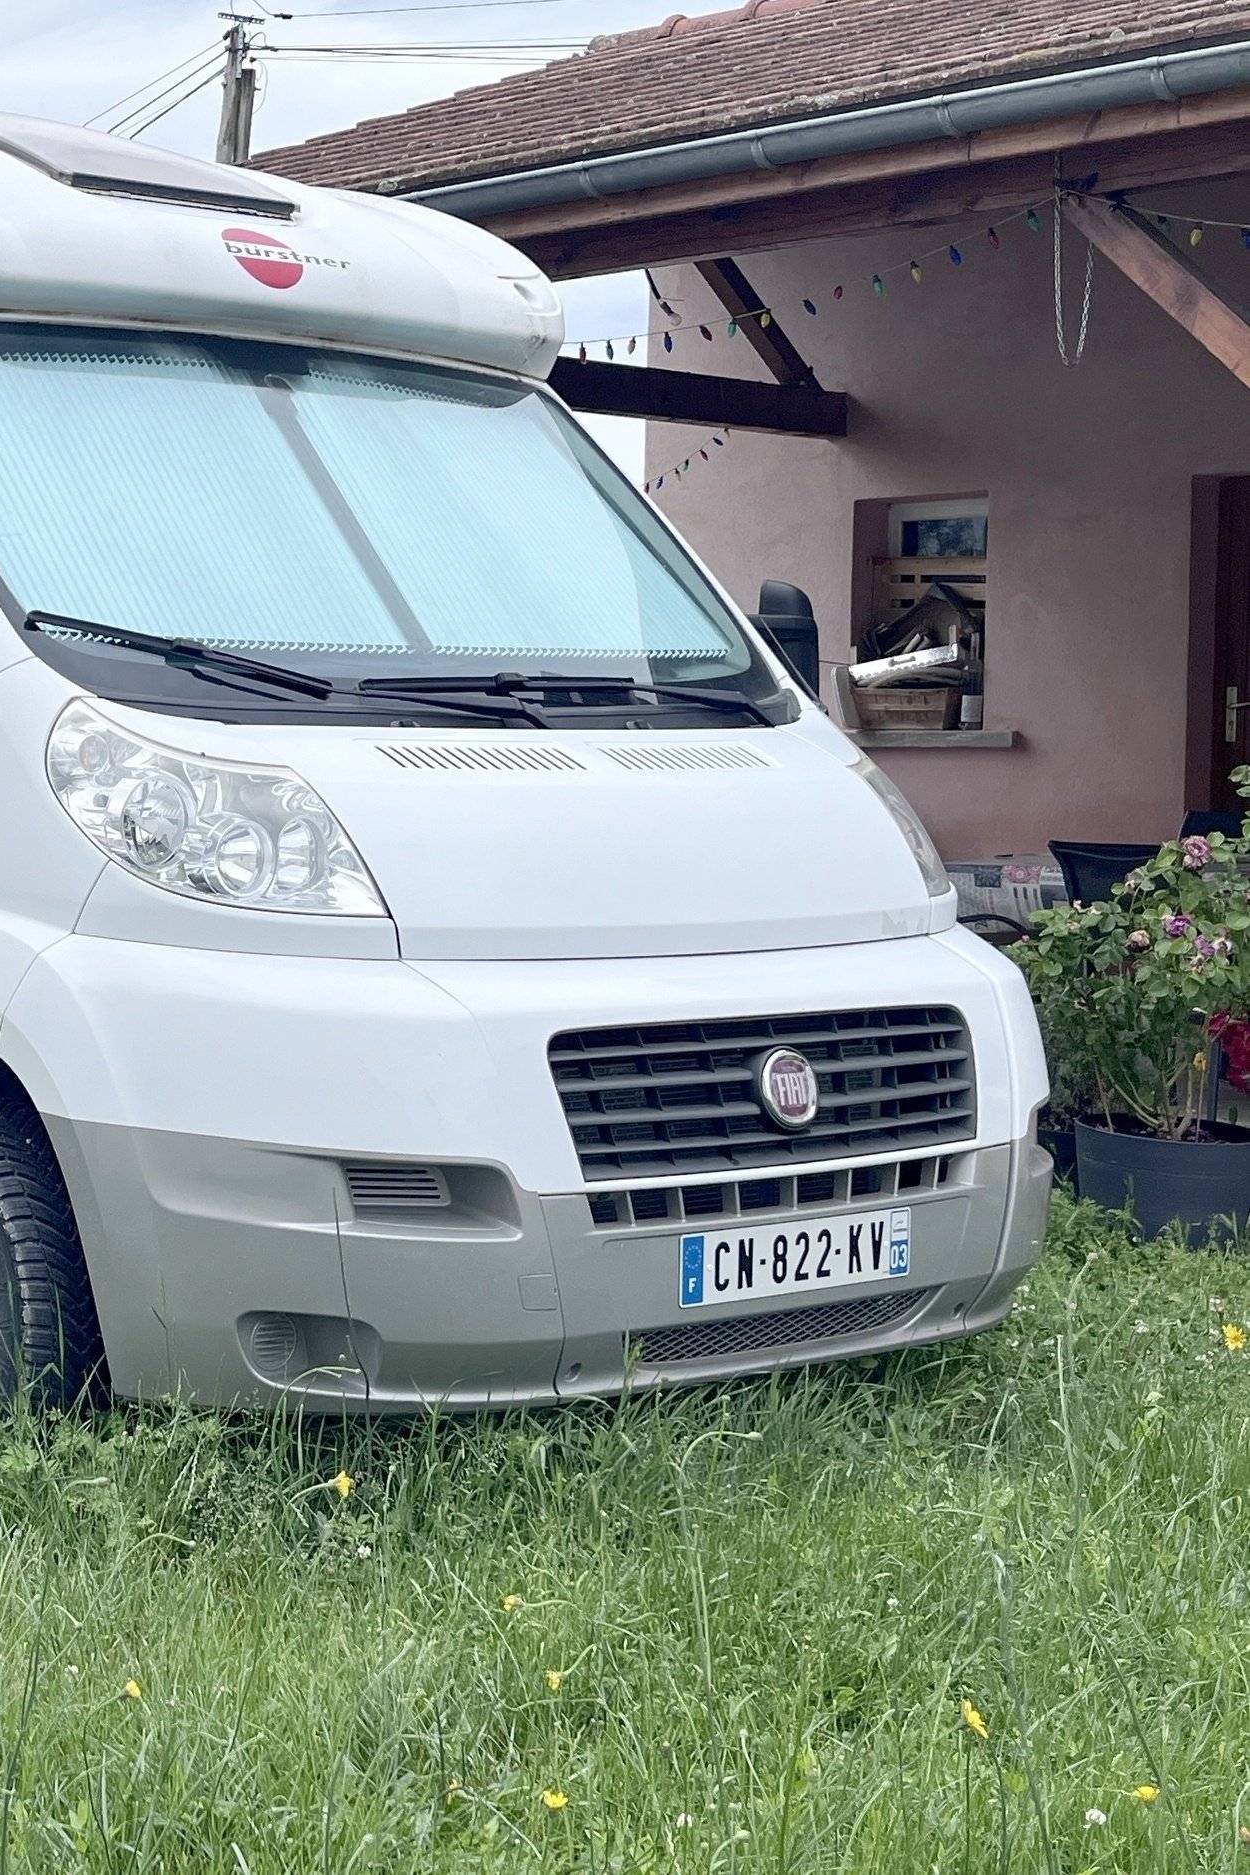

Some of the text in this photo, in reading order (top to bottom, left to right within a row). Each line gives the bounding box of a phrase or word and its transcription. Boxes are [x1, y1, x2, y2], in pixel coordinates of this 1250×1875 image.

[224, 241, 351, 270] bürstner
[776, 1072, 808, 1106] FIAT
[688, 1221, 909, 1294] F CN-822-KV 03
